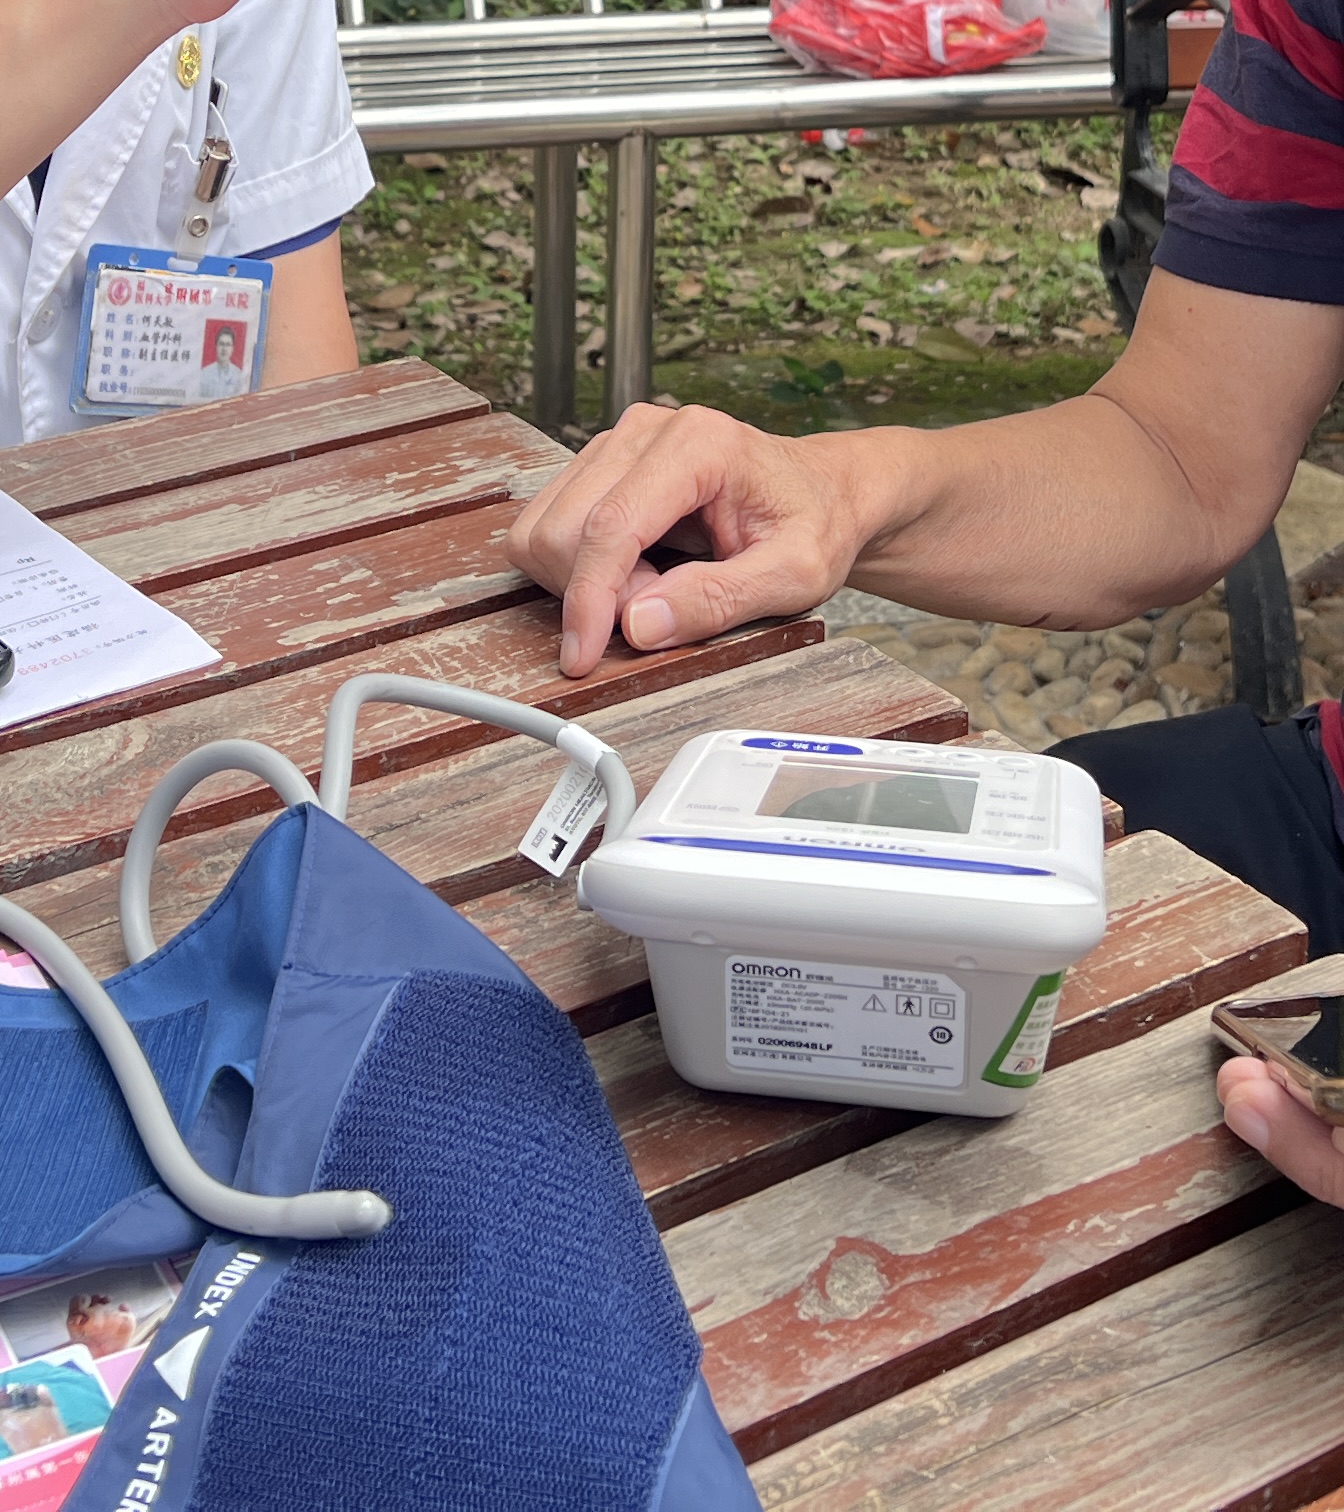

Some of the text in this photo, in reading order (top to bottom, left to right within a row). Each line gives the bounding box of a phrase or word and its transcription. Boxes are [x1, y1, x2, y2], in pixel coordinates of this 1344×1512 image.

[176, 287, 249, 309] 附属第一医院
[139, 332, 182, 347] 血管外科
[138, 348, 191, 362] 副主任医师
[732, 962, 802, 979] OMRON
[192, 1250, 263, 1320] INDEX
